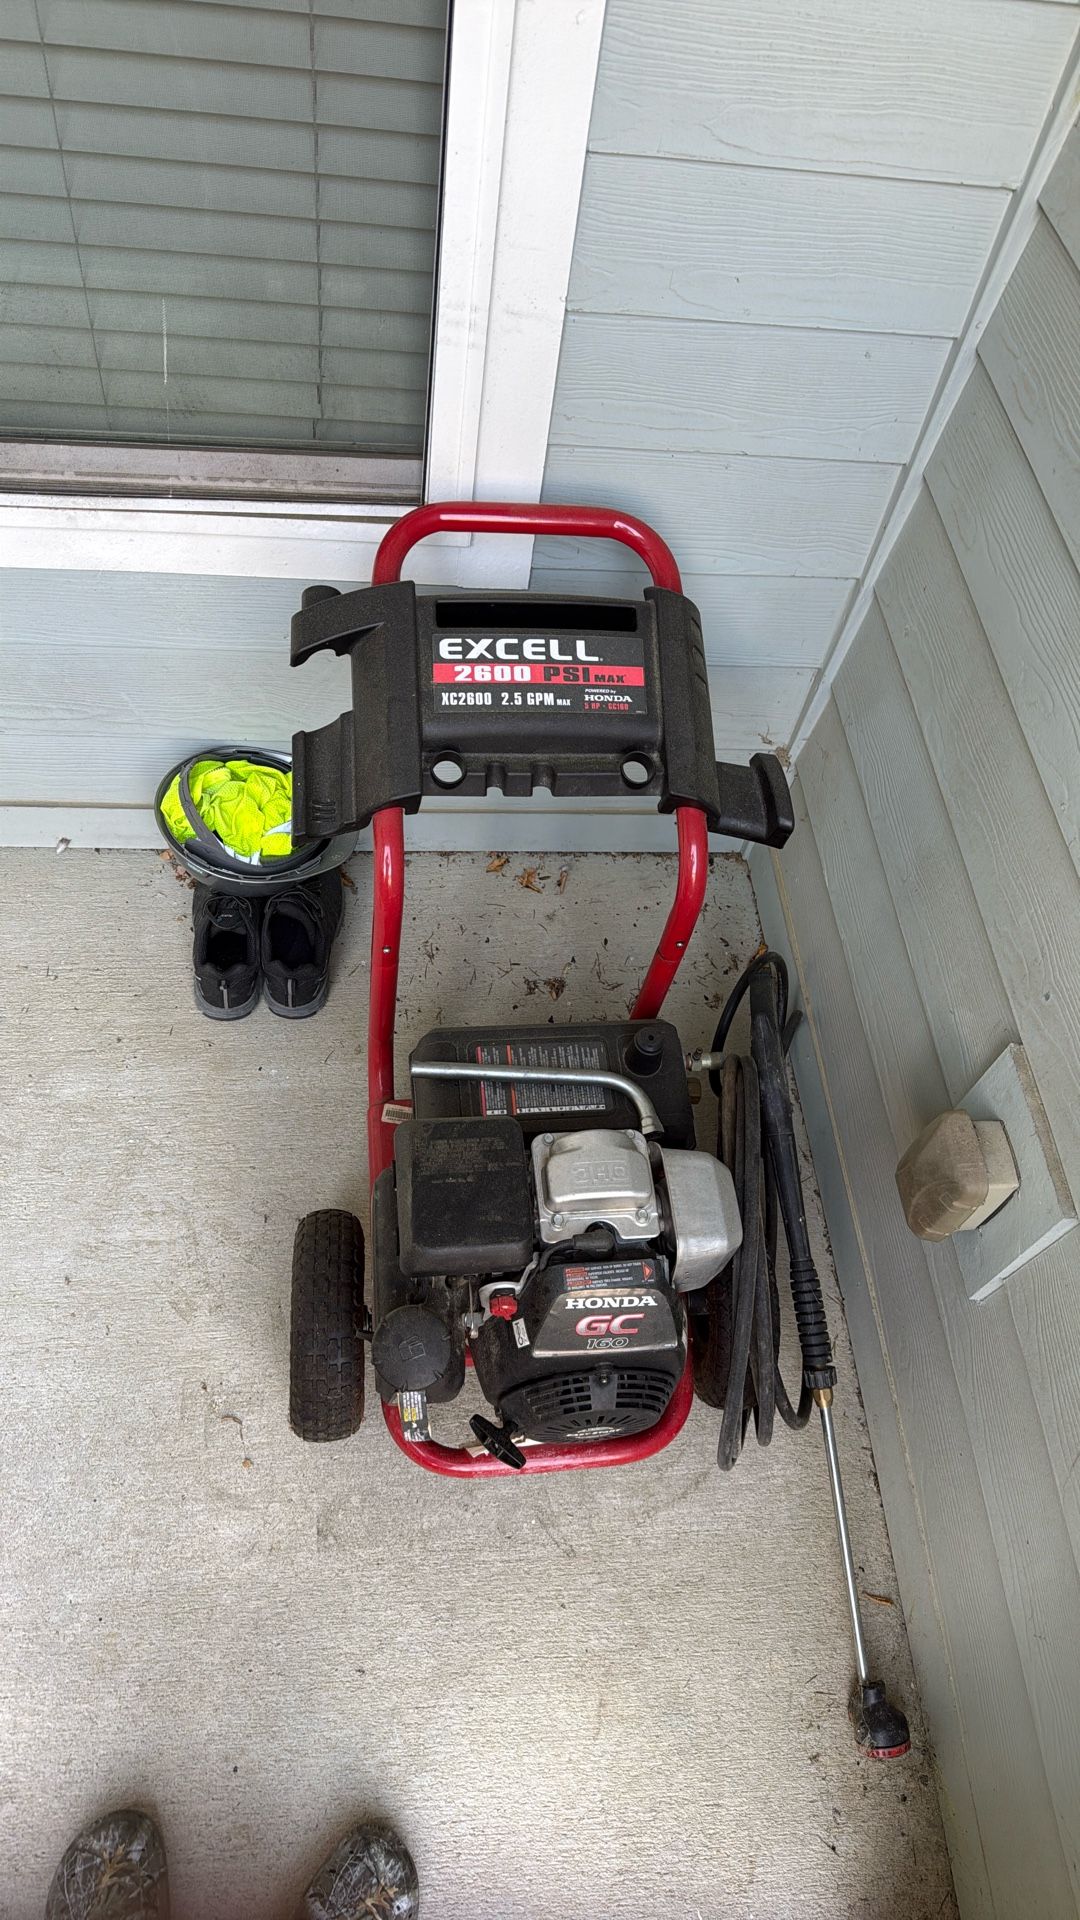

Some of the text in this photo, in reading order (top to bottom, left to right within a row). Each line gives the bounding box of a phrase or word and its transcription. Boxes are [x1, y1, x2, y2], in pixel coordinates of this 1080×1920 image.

[439, 638, 600, 662] EXCELL
[454, 665, 625, 683] 2600 PSI MAX
[441, 692, 492, 706] XC2600
[501, 692, 522, 706] 2.5
[526, 692, 555, 706] GPM
[584, 695, 633, 703] HONDA
[565, 1296, 658, 1309] HONDA
[575, 1313, 645, 1336] GC
[587, 1337, 629, 1350] 160
